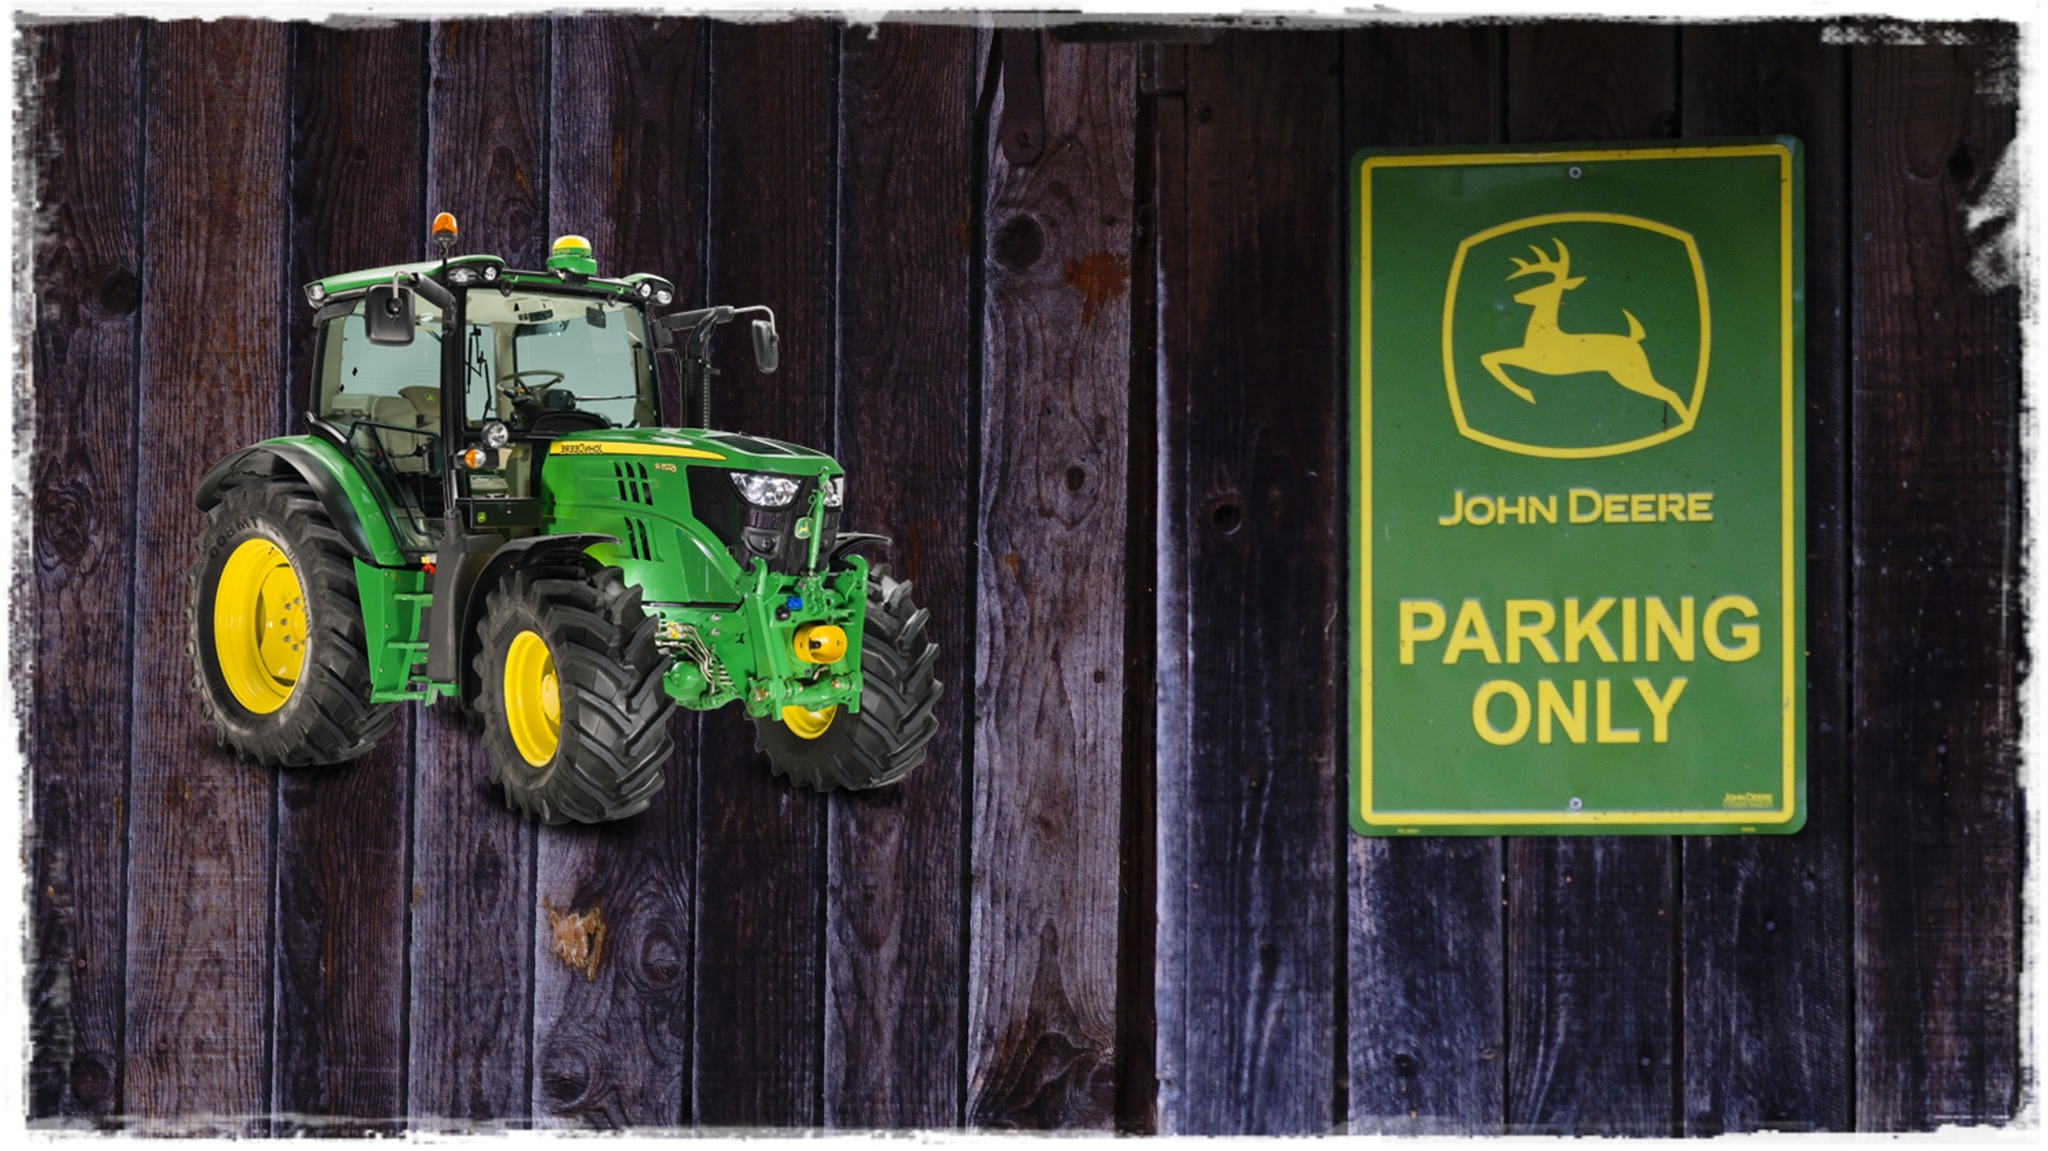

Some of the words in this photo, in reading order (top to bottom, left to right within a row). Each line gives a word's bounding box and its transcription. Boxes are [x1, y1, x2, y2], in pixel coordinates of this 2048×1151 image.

[1438, 489, 1558, 527] JOHN
[1568, 488, 1714, 524] DEERE
[1398, 595, 1761, 665] PARKING
[1472, 677, 1689, 746] ONLY
